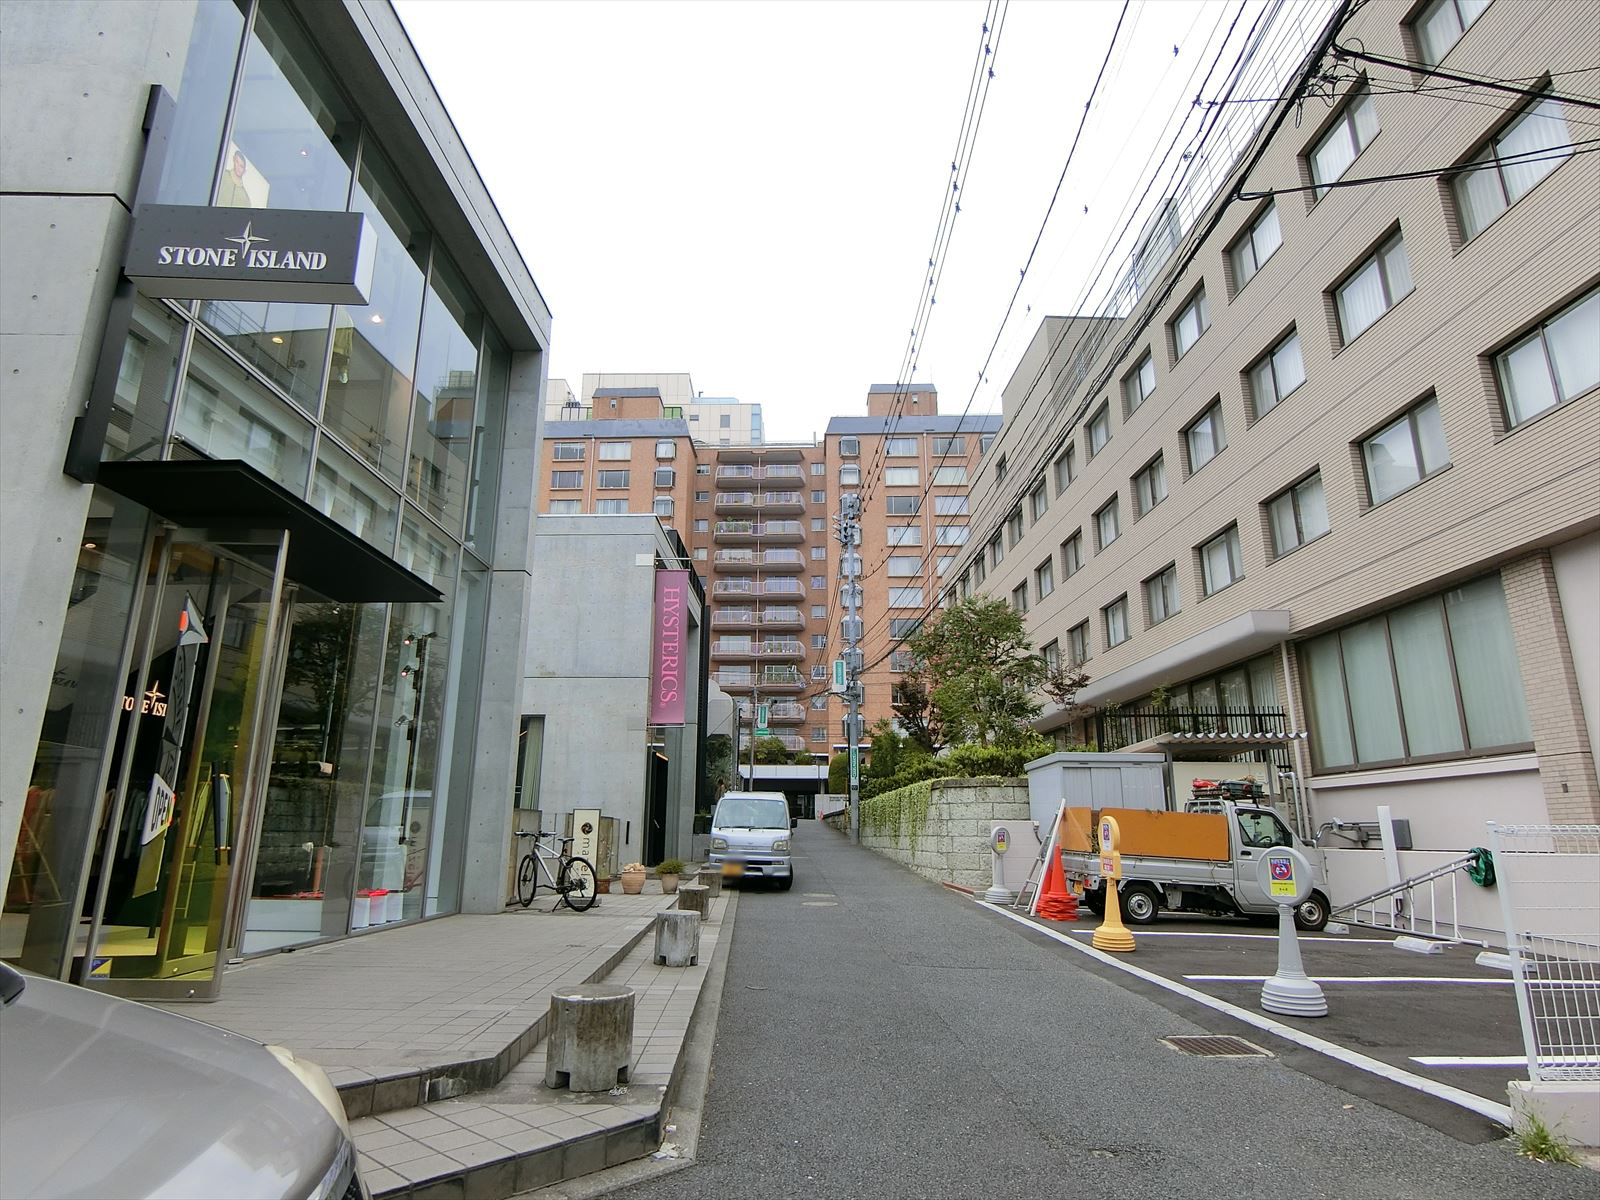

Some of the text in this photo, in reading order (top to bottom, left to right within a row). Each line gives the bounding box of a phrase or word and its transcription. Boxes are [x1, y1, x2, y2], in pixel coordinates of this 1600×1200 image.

[158, 245, 328, 271] STONE ISLAND
[150, 786, 172, 833] OPEN
